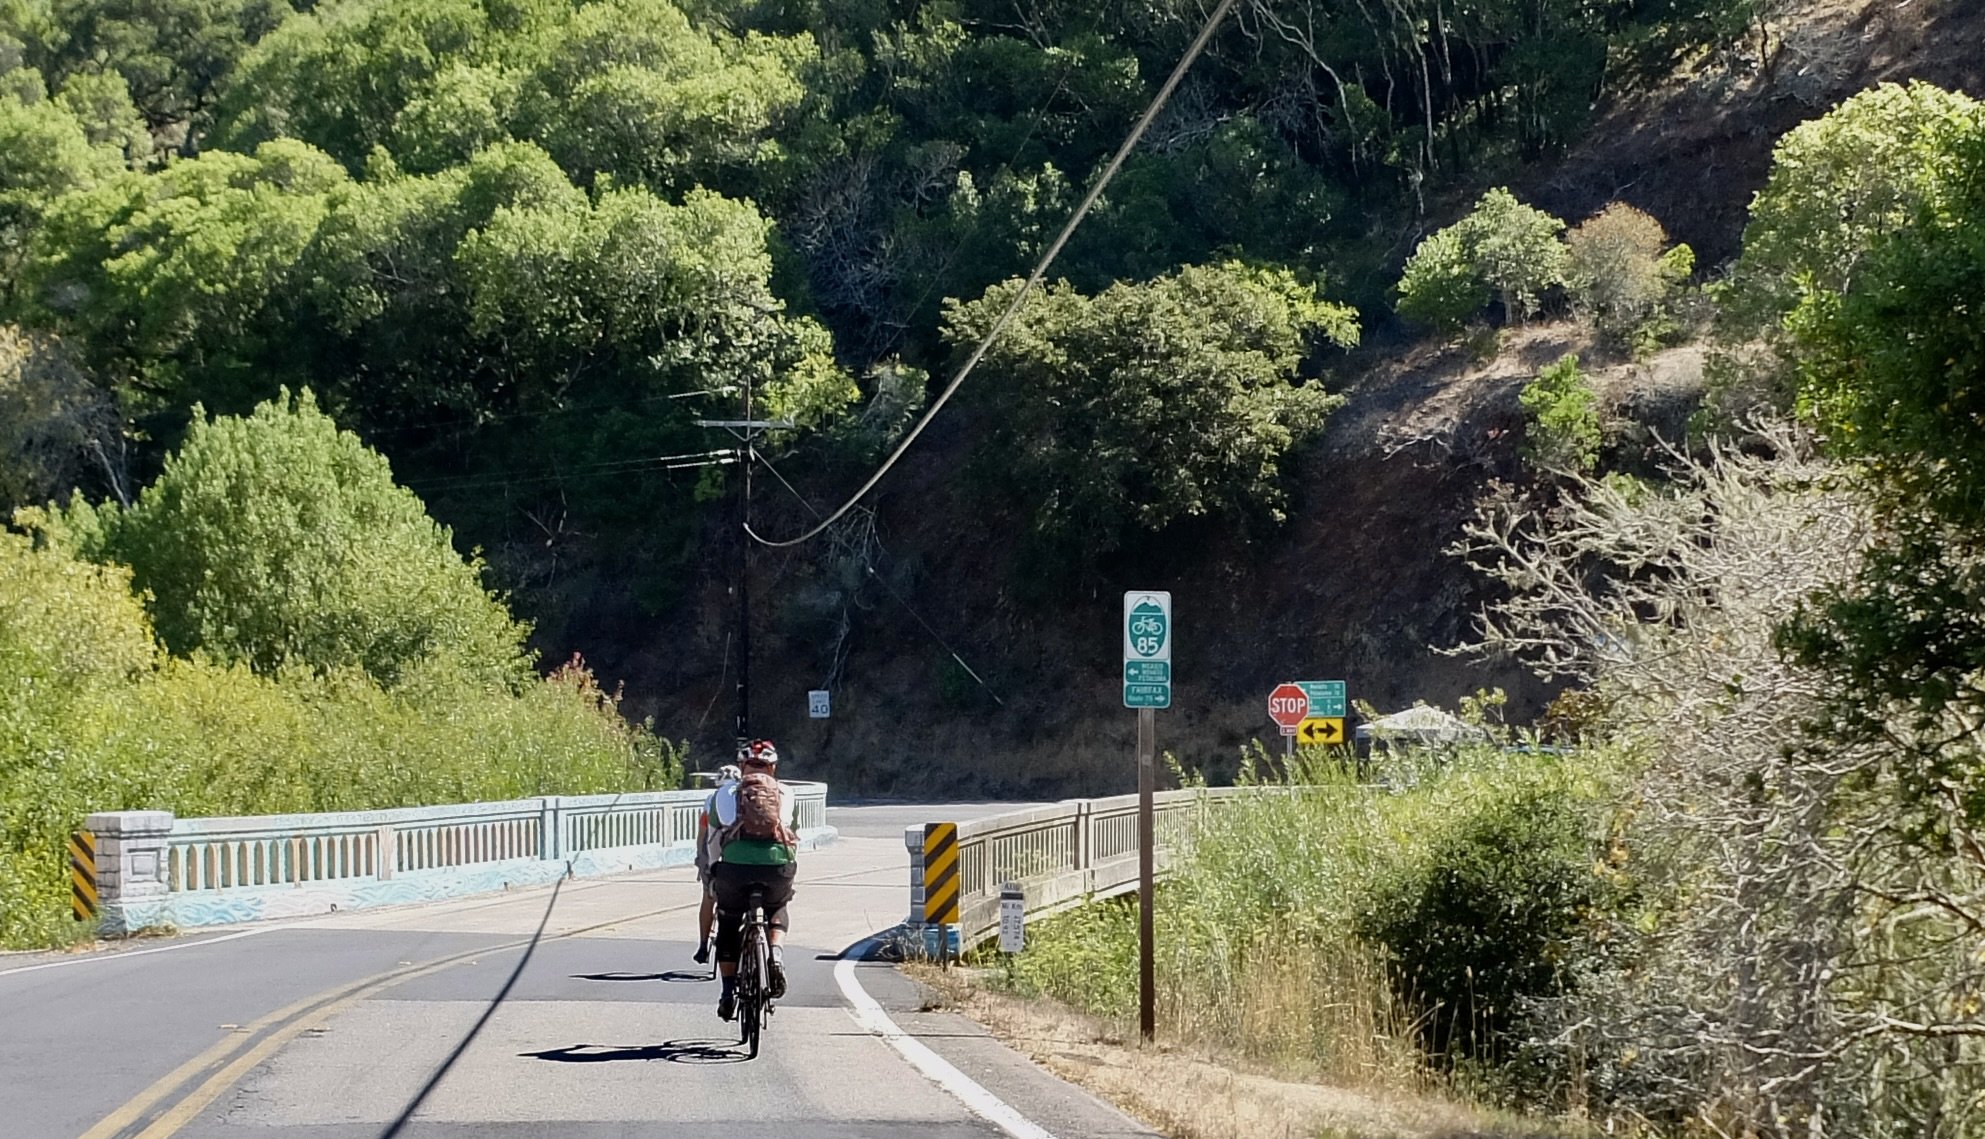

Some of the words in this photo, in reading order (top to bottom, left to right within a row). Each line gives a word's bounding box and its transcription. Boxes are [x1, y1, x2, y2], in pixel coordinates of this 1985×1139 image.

[1137, 636, 1159, 654] 85
[811, 704, 828, 714] 40
[1271, 697, 1306, 714] STOP
